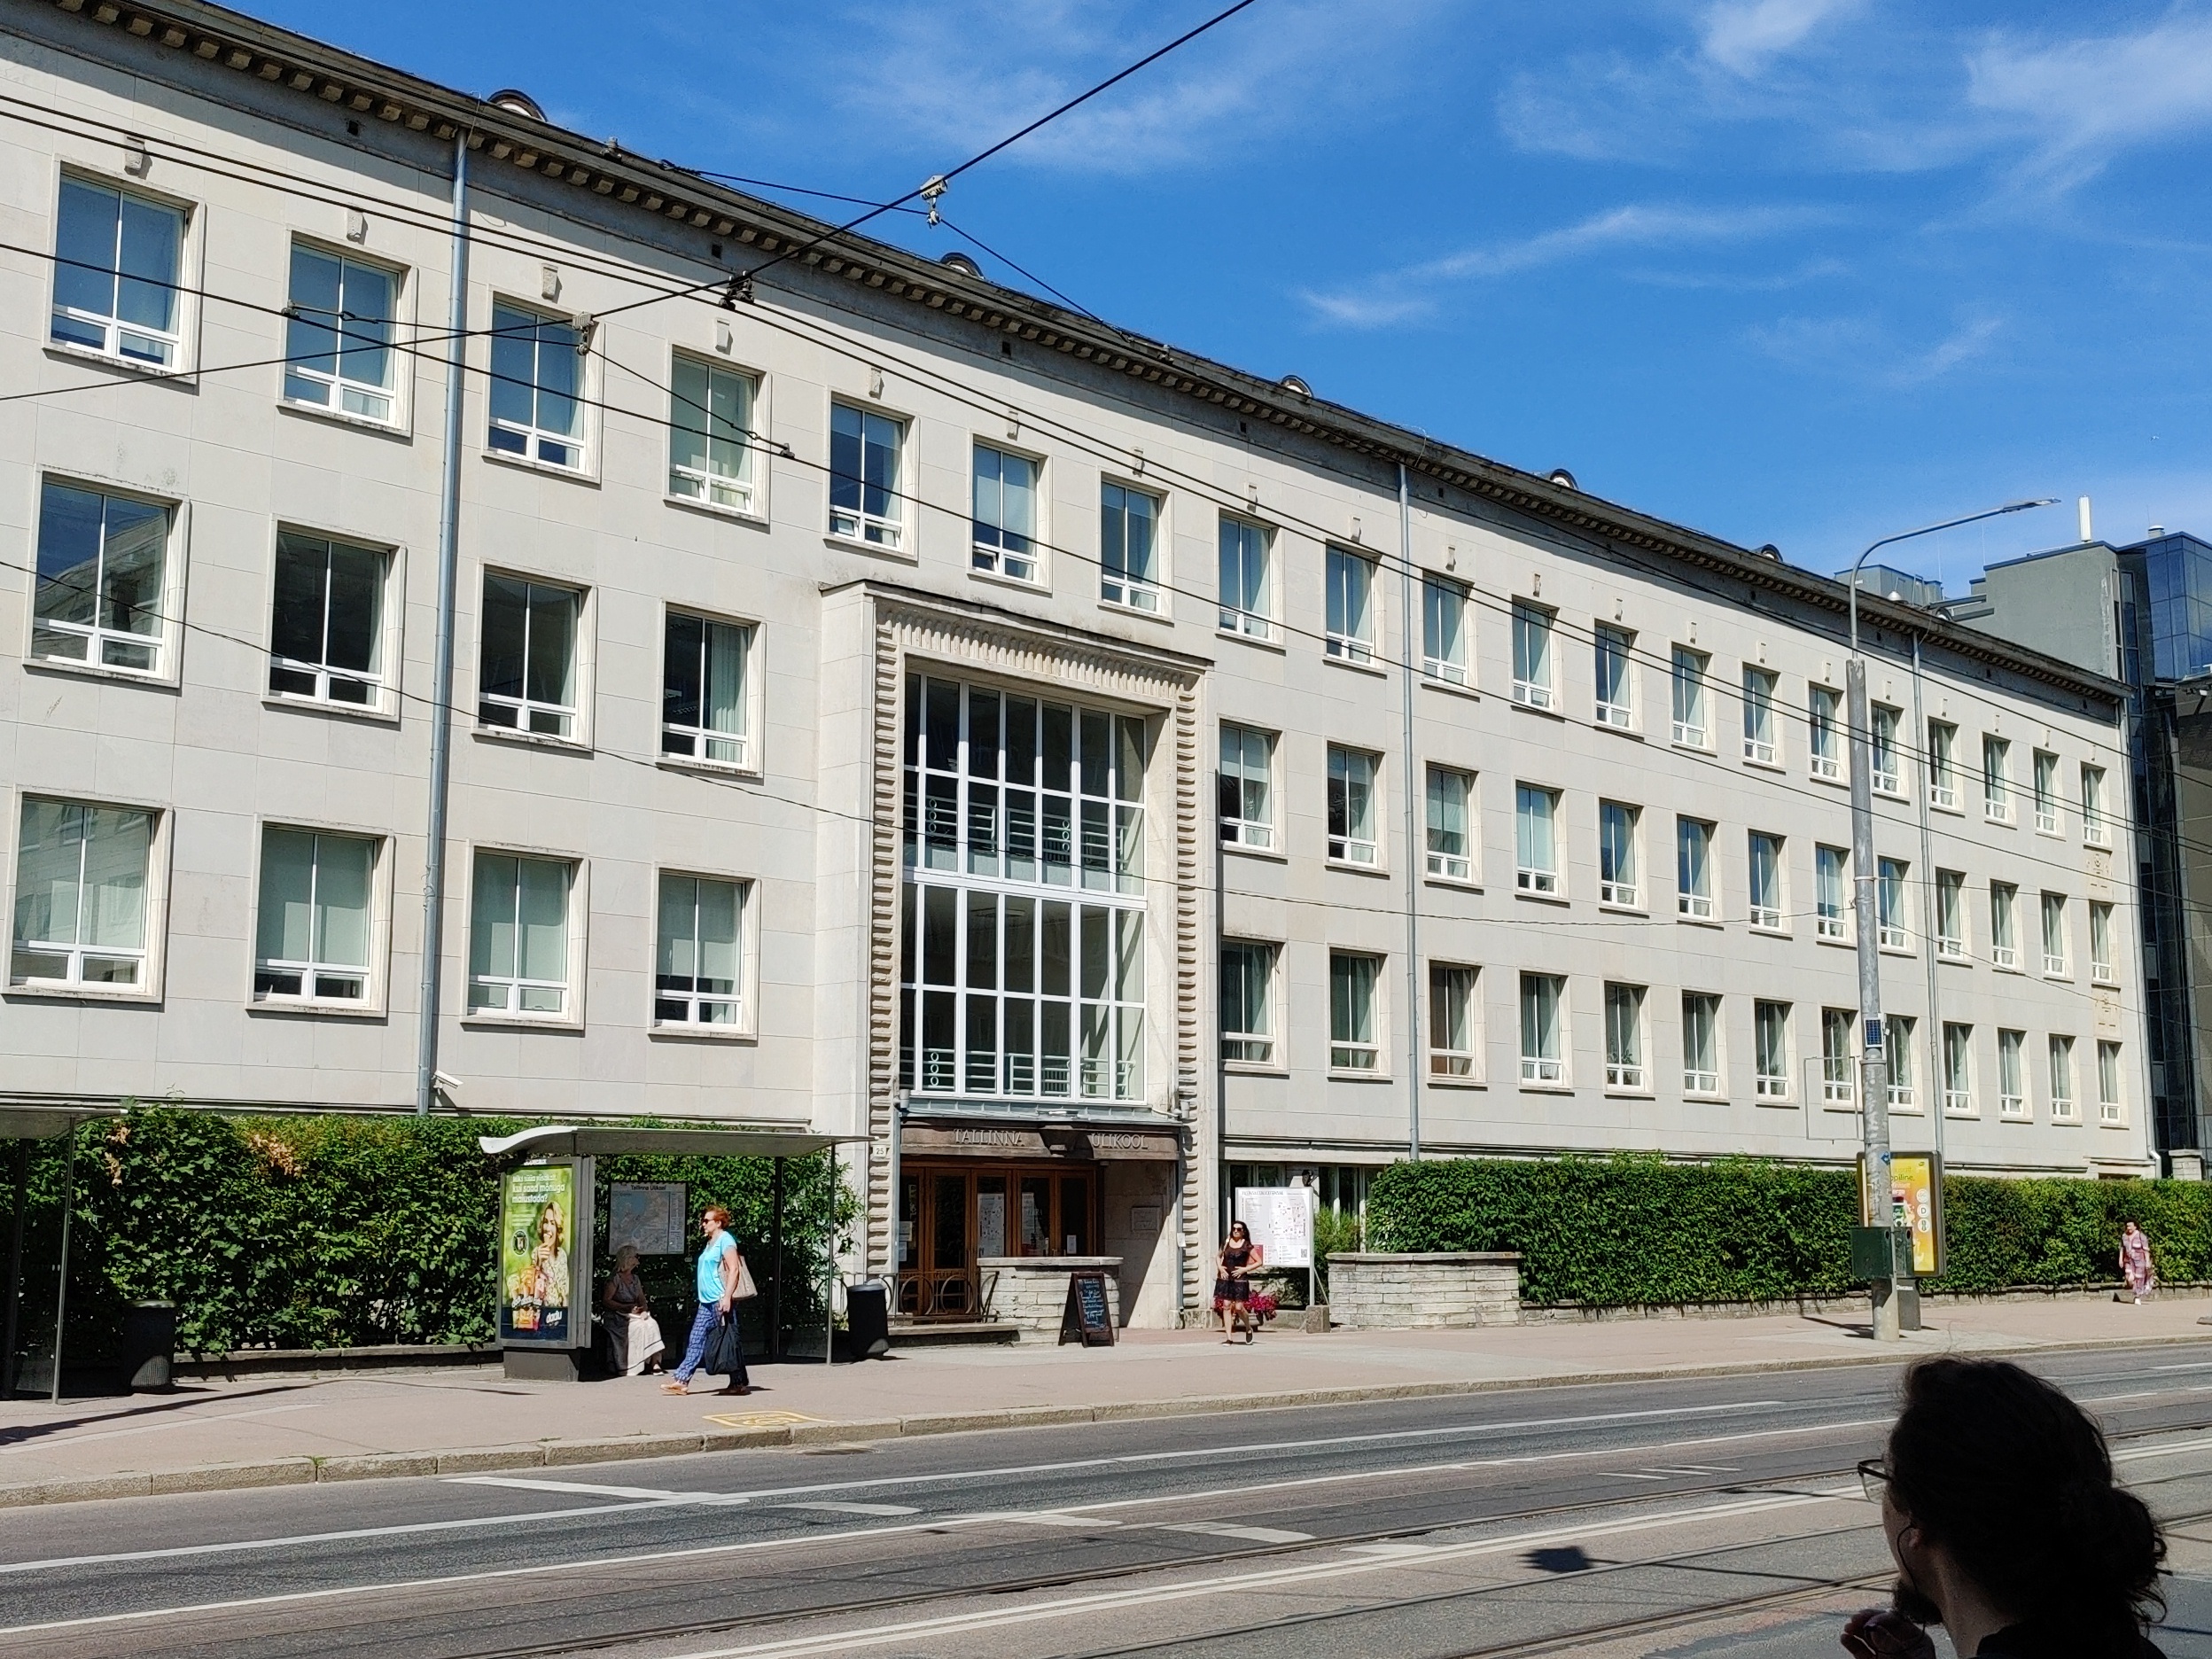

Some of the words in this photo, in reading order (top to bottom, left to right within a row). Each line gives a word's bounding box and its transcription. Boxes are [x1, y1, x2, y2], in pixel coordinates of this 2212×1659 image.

[954, 1128, 1025, 1147] TALLINNA
[1091, 1133, 1149, 1150] ÜLIKOOL
[523, 1183, 539, 1192] saad
